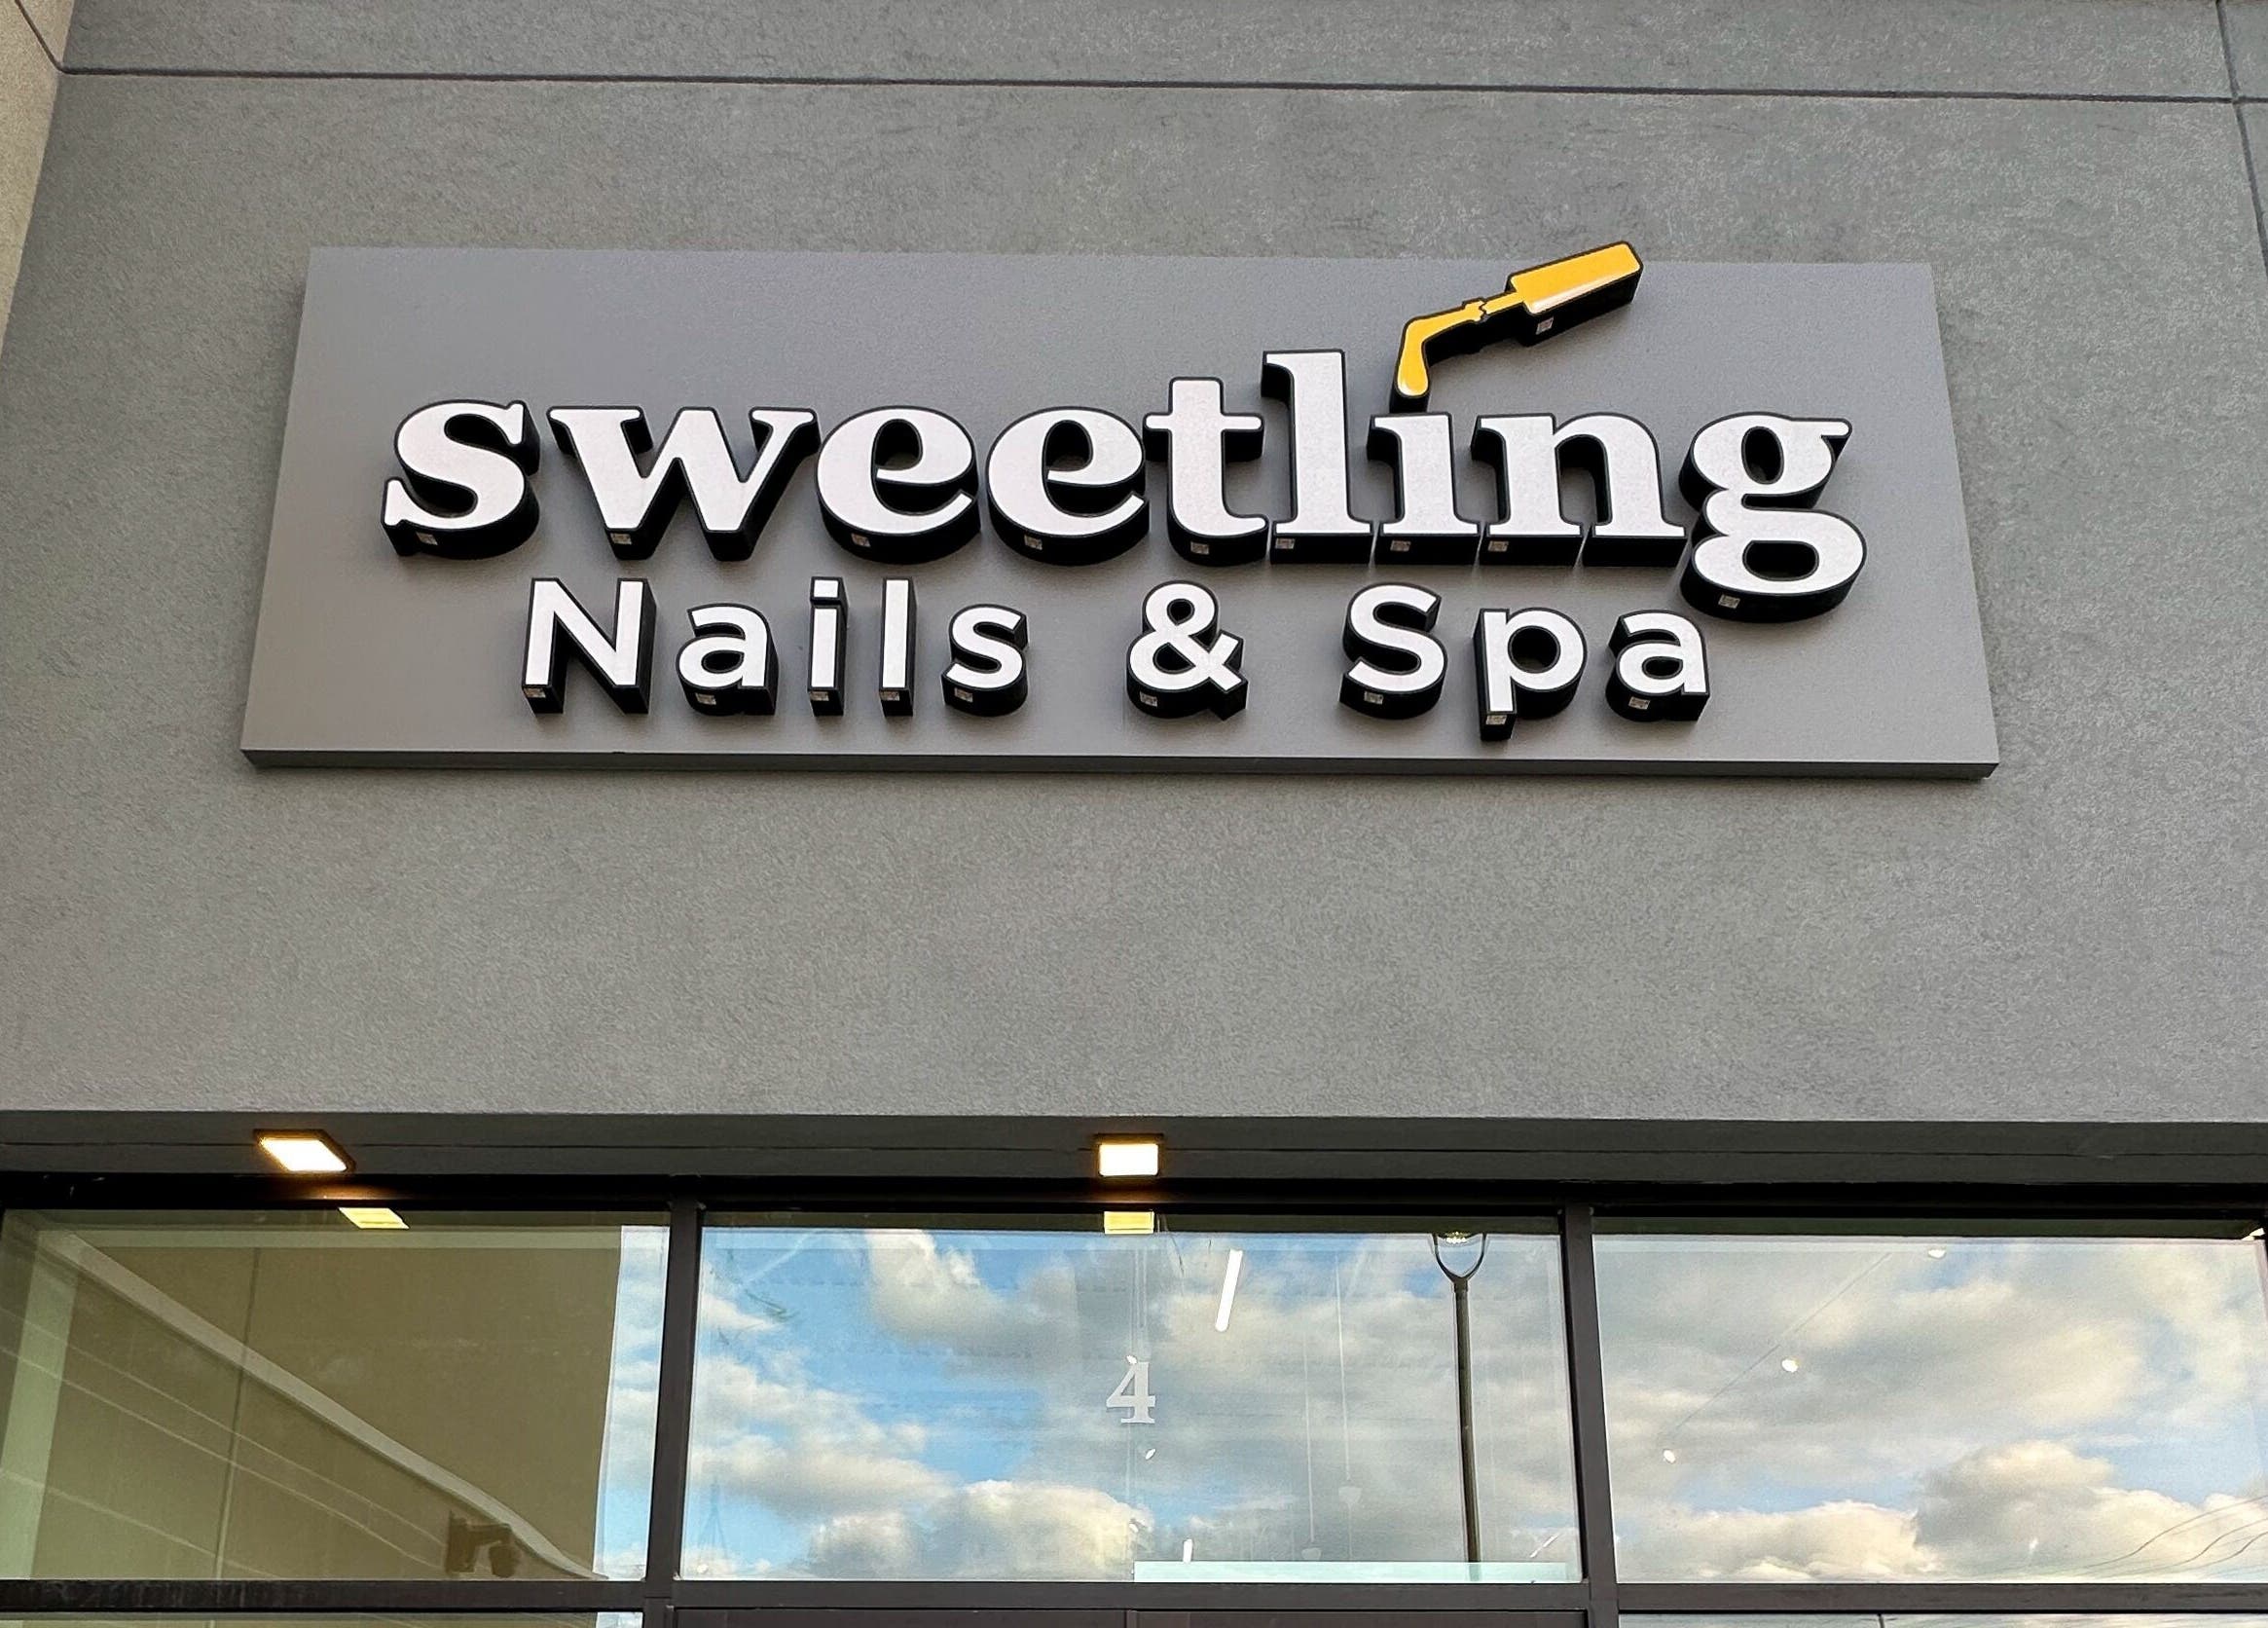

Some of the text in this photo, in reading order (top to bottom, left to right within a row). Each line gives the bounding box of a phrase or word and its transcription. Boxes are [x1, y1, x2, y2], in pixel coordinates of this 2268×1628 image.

[383, 349, 1867, 606] sweetling
[523, 577, 1709, 716] Nails & Spa
[1105, 1359, 1157, 1424] 4
